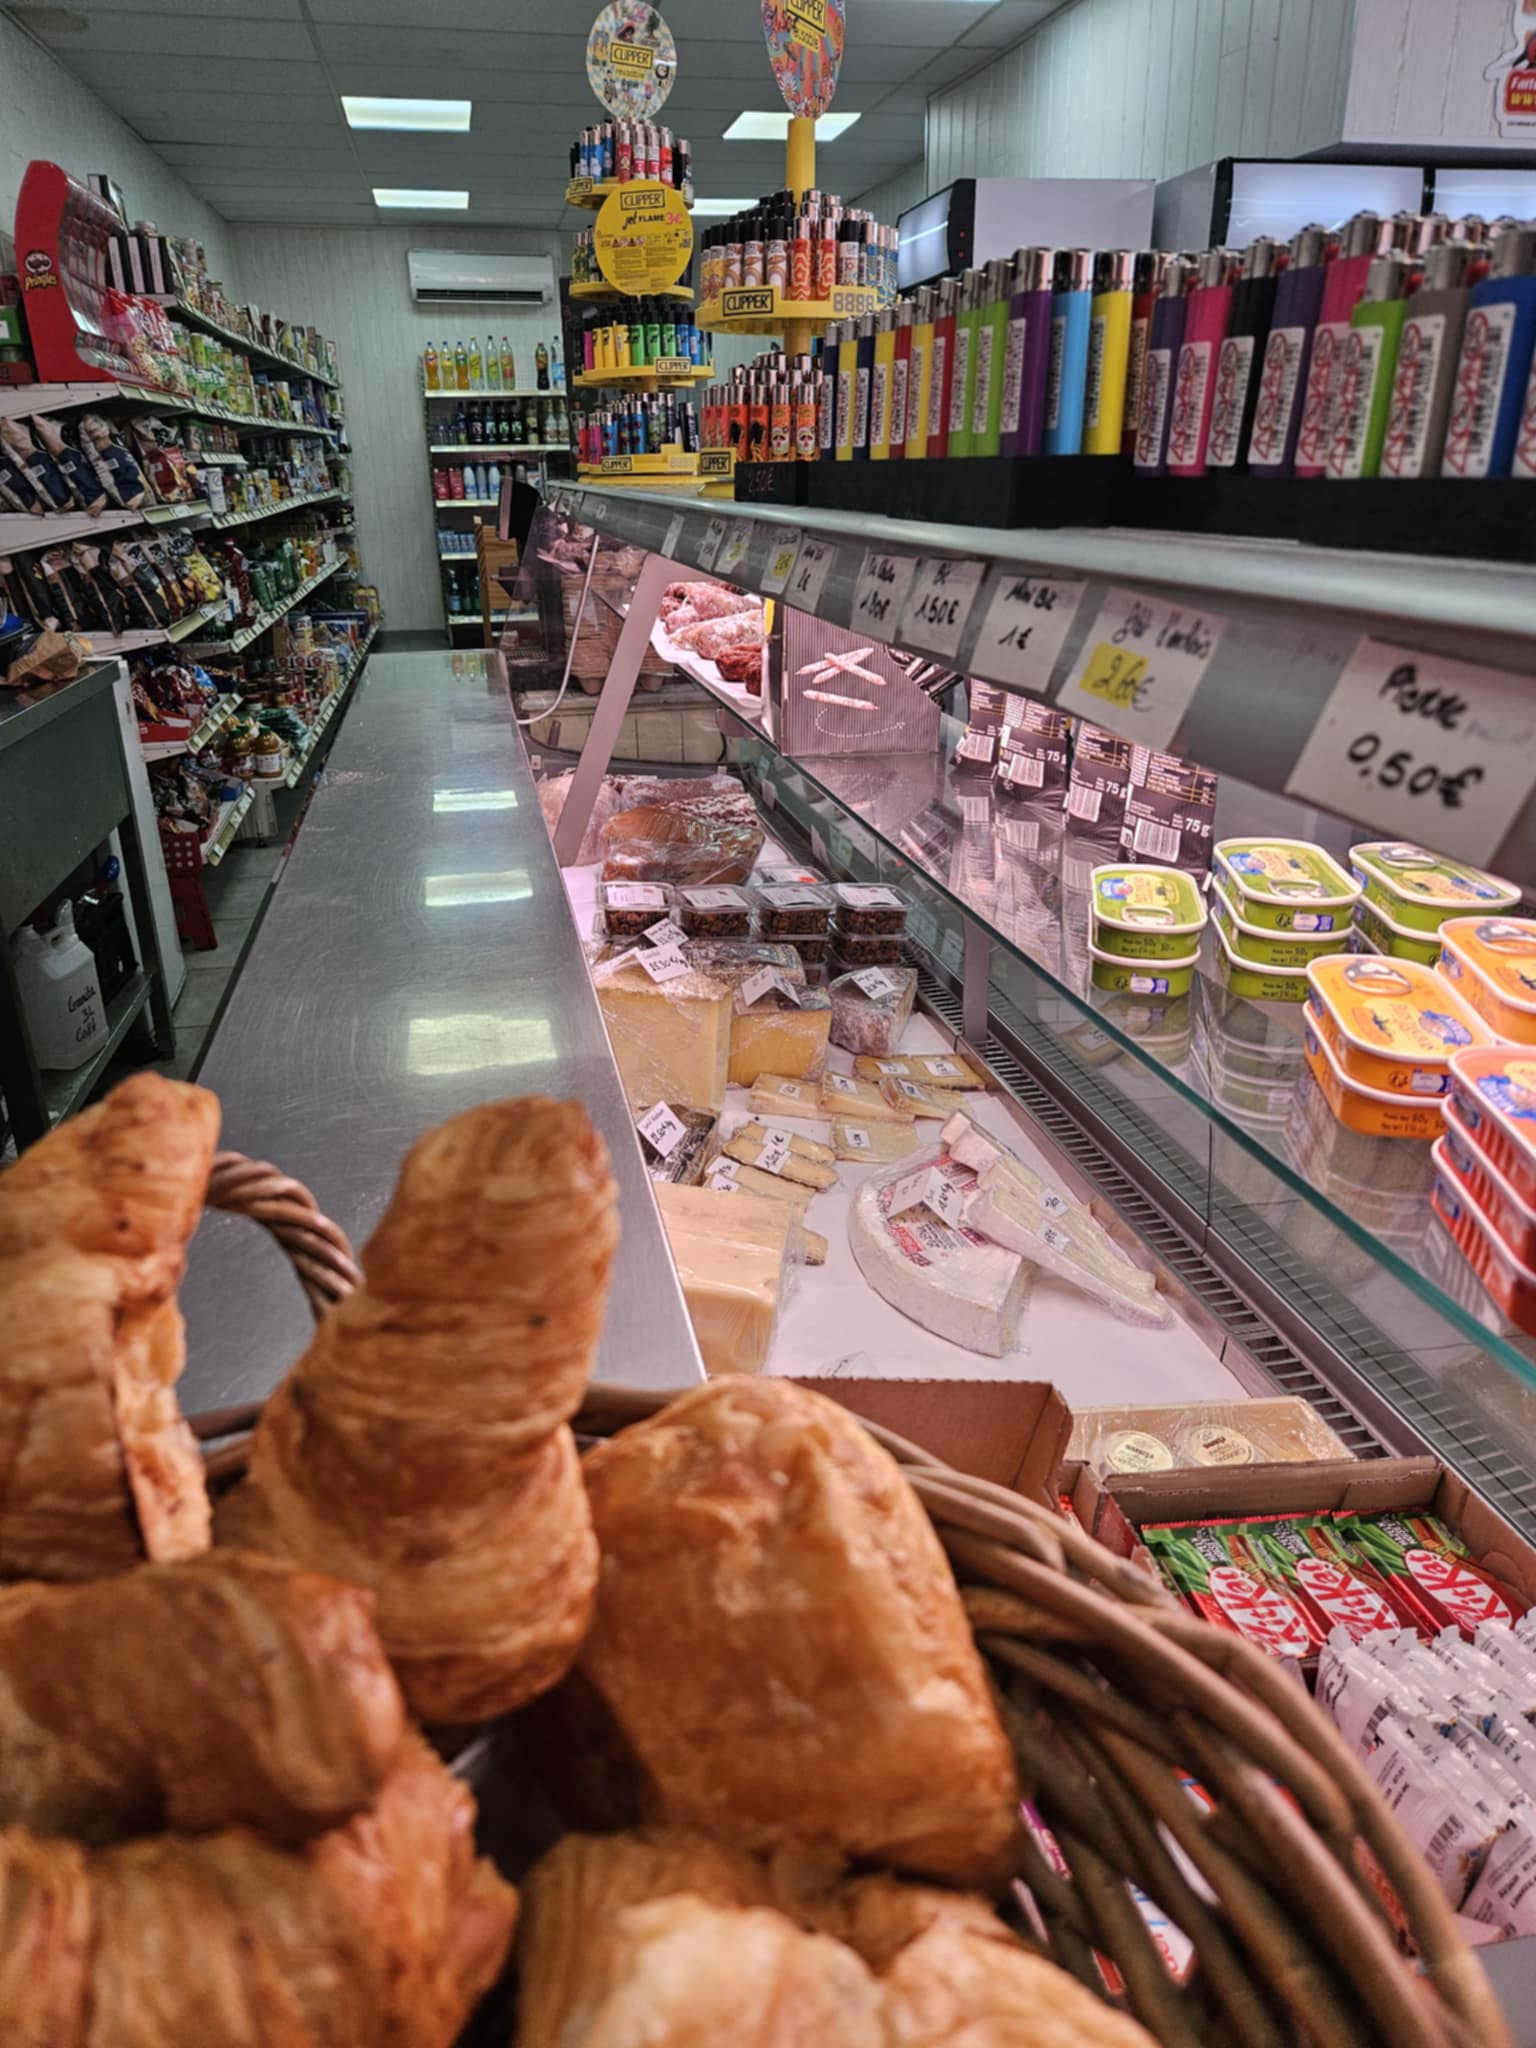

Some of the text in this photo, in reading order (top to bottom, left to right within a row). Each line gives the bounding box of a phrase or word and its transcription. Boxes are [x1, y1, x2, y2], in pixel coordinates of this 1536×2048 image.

[613, 46, 650, 65] CLIPPER
[622, 193, 661, 207] CLIPPER
[638, 214, 665, 223] FLAME
[725, 293, 770, 312] CLIPPER
[658, 359, 690, 371] CLIPPER
[602, 458, 630, 471] CLIPPER
[1047, 750, 1062, 762] 75
[1106, 780, 1121, 795] 75
[1185, 817, 1212, 838] 75 g
[1409, 1552, 1511, 1622] KitKat
[1299, 1560, 1396, 1632] KitKat
[1212, 1569, 1308, 1645] KitKat
